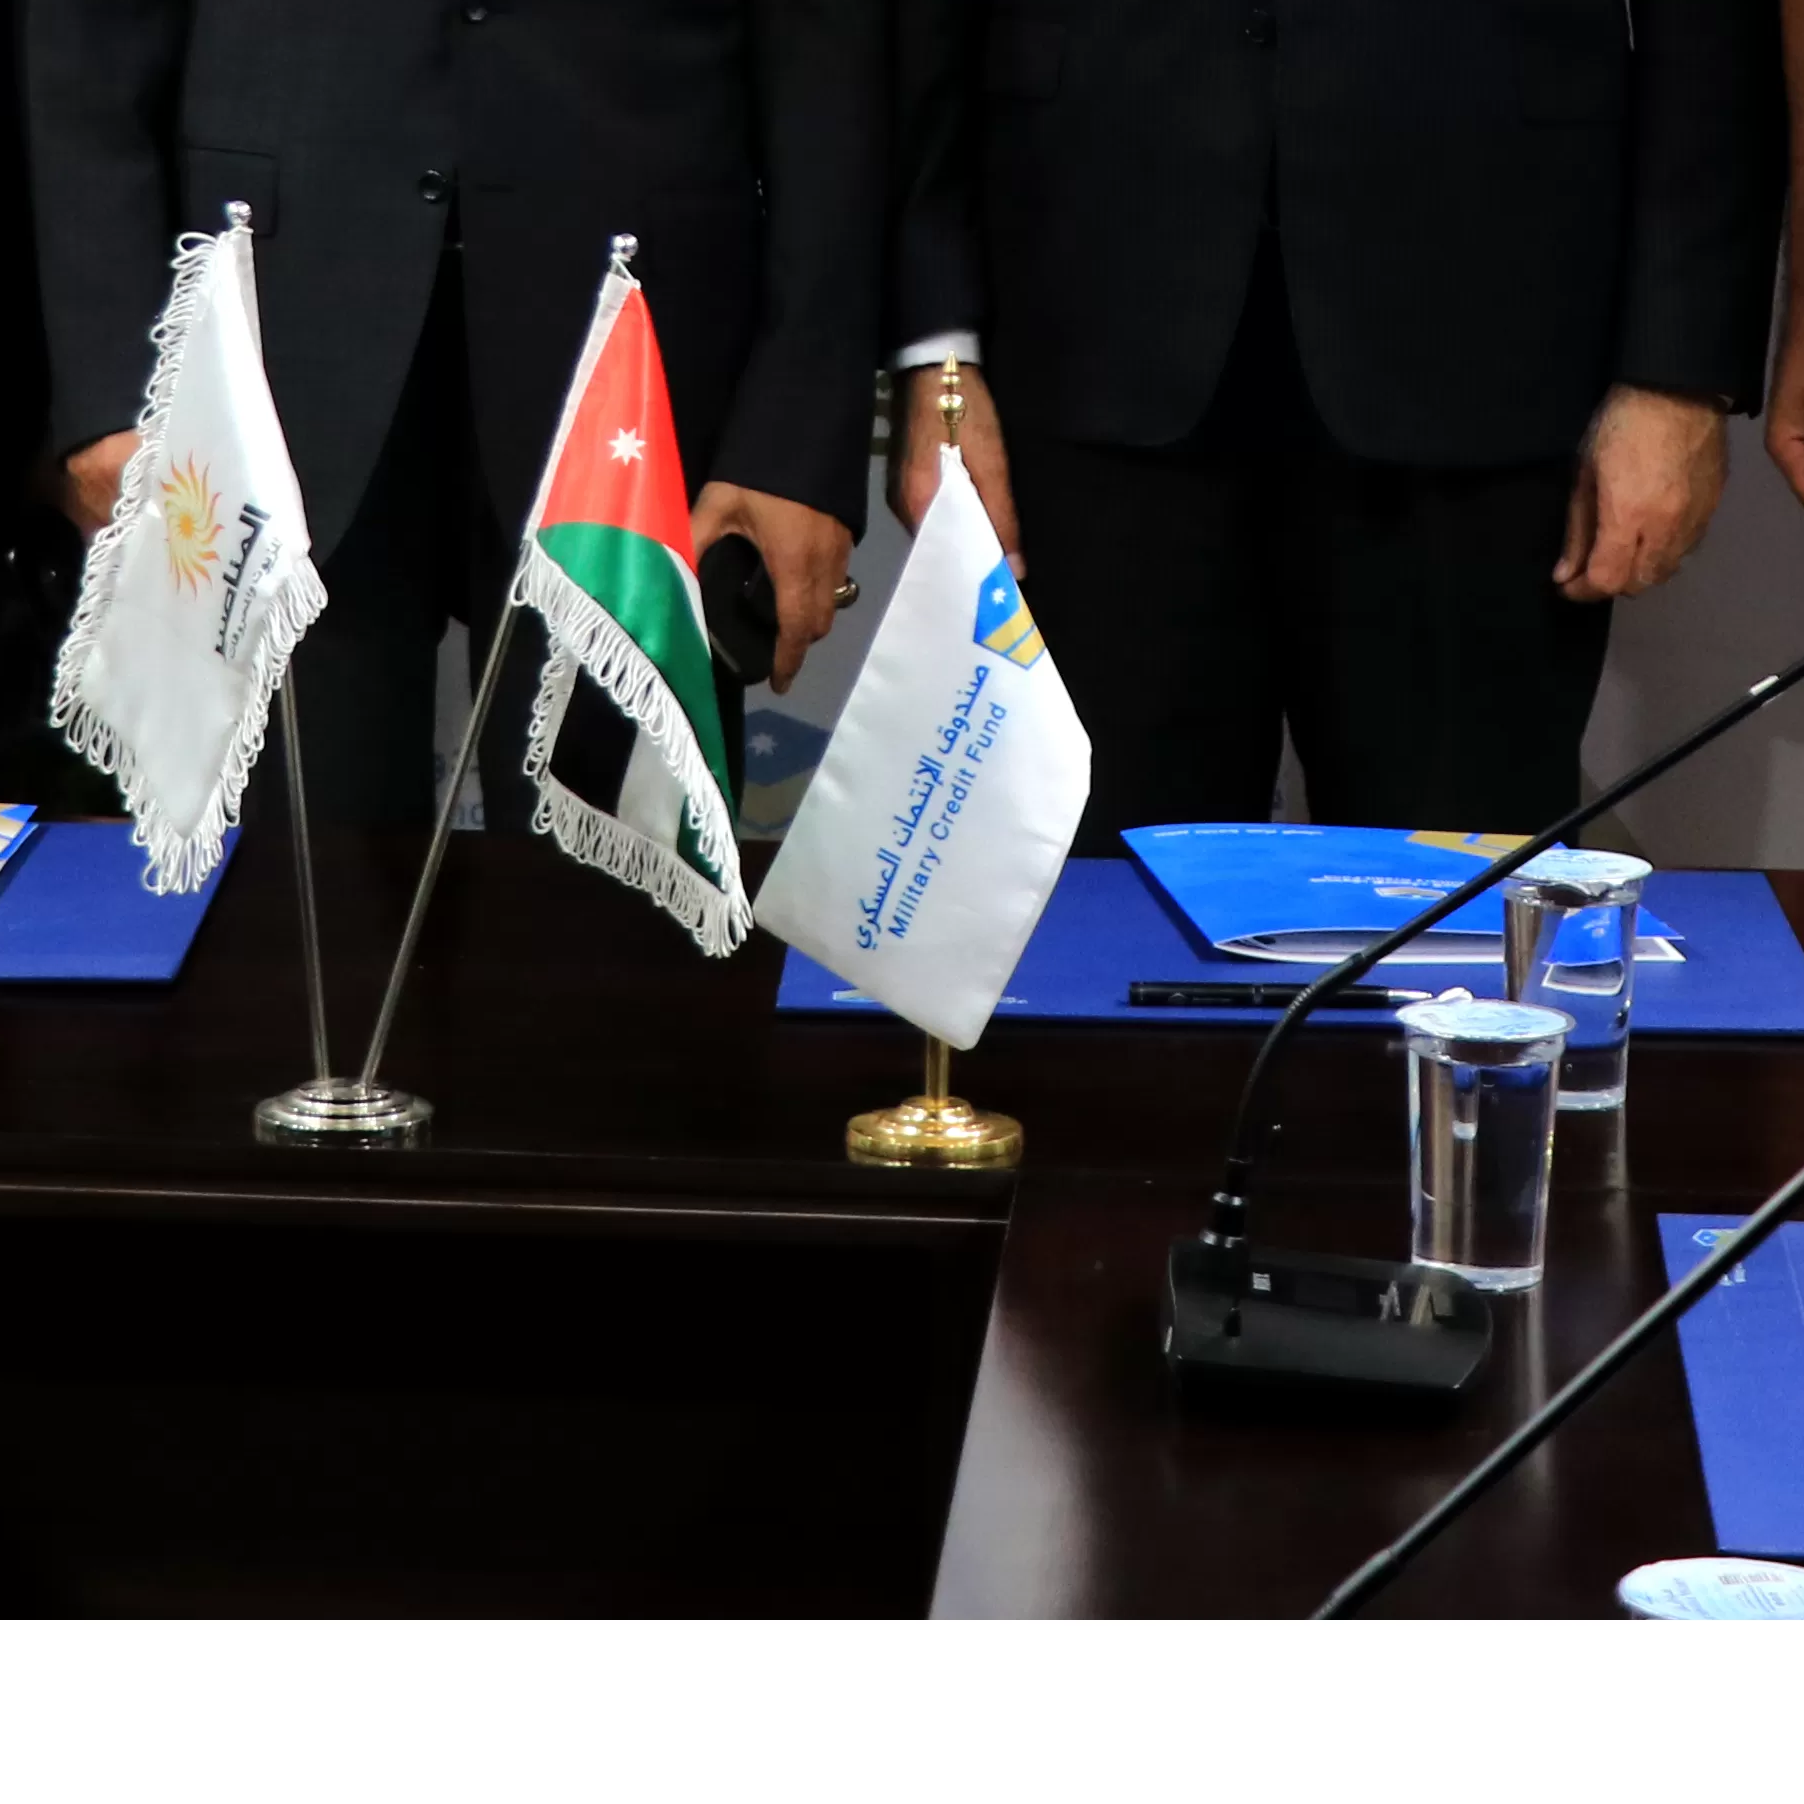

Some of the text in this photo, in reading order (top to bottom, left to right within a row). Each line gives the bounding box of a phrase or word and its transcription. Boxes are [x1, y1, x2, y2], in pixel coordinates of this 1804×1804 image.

[215, 503, 272, 663] المناصير
[937, 664, 990, 755] صندوق
[888, 701, 1007, 939] Military Credit Fund
[856, 847, 902, 951] العسكري
